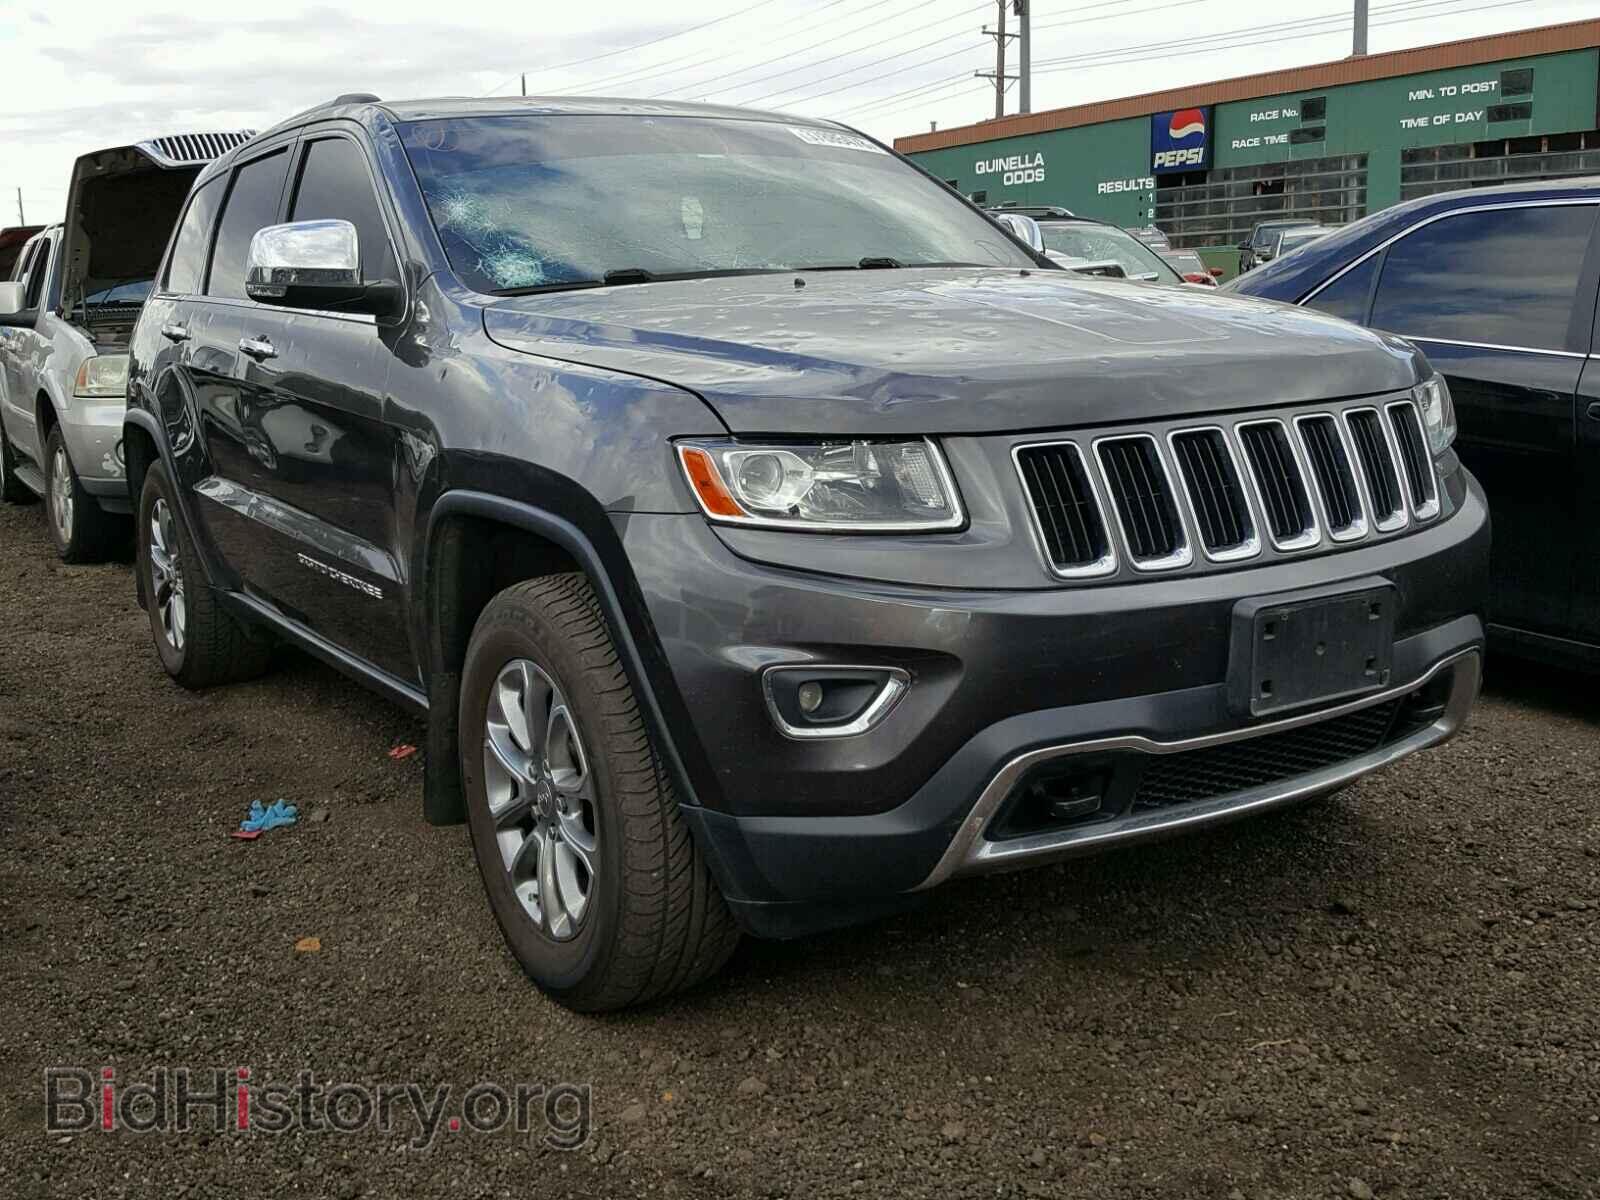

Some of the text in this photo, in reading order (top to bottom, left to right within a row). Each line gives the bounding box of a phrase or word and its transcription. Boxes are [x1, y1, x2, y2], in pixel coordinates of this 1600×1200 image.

[1408, 80, 1498, 101] MIN. TO POST
[1250, 108, 1299, 122] RACE No.
[1399, 110, 1484, 129] TIME OF DAY
[1231, 133, 1288, 149] RACE TIME
[975, 152, 1045, 175] QUINELLA
[1153, 147, 1204, 169] PEPSI
[1003, 168, 1045, 186] ODDS
[1097, 178, 1155, 195] RESULTS
[1148, 192, 1153, 202] 1
[1147, 209, 1154, 218] 2
